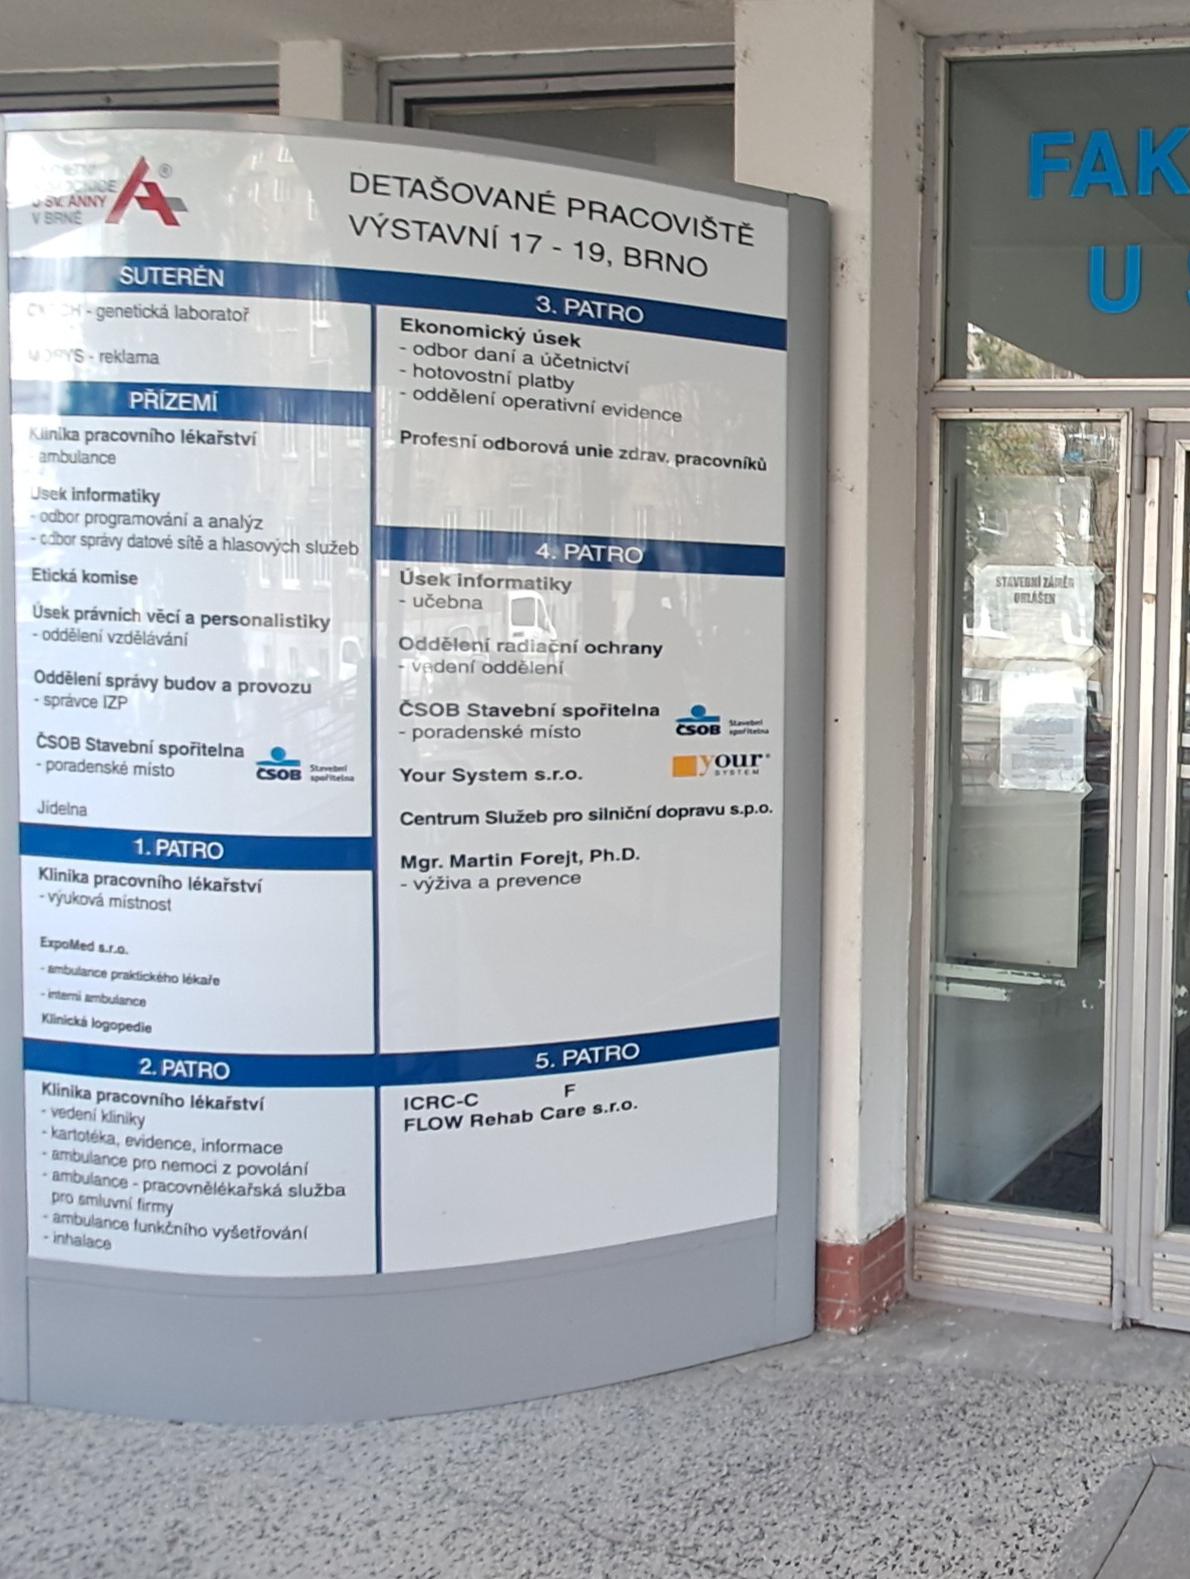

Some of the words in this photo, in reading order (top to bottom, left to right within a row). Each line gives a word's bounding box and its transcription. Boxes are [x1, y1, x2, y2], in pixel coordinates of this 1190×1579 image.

[350, 171, 556, 215] DETAŠOVANÉ
[568, 198, 755, 247] PRACOVIŠTĚ
[348, 212, 498, 250] VÝSTAVNÍ
[510, 232, 542, 254] 17
[575, 241, 613, 268] 19,
[625, 248, 708, 277] BRNO
[120, 266, 224, 288] SUTERÉN
[1089, 244, 1142, 314] U
[96, 304, 169, 321] genetická
[175, 305, 249, 322] laboratoř
[536, 296, 556, 315] 3.
[565, 298, 644, 324] PATRO
[400, 318, 526, 346] Ekonomický
[533, 328, 580, 348] úsek
[100, 350, 159, 365] reklama
[413, 342, 467, 360] odbor
[476, 346, 516, 363] daní
[523, 353, 533, 365] a
[541, 351, 630, 375] účetnictví
[413, 365, 510, 386] hotovostní
[518, 371, 575, 394] platby
[130, 390, 218, 412] PŘÍZEMÍ
[413, 387, 496, 405] oddělení
[502, 393, 595, 415] operativní
[602, 404, 682, 423] evidence
[400, 430, 476, 450] Profesní
[483, 436, 569, 456] odborová
[576, 443, 613, 458] unie
[619, 447, 669, 464] zdrav.
[675, 450, 767, 472] pracovníků
[536, 543, 556, 561] 4.
[564, 545, 643, 563] PATRO
[32, 568, 77, 583] Etická
[82, 570, 138, 585] komise
[400, 570, 450, 587] Úsek
[458, 573, 571, 594] informatiky
[413, 594, 482, 610] učebna
[33, 605, 69, 620] Úsek
[74, 607, 141, 623] právních
[147, 608, 180, 624] věcí
[186, 614, 195, 624] a
[201, 613, 331, 632] personalistiky
[400, 636, 490, 653] Oddělení
[497, 639, 579, 654] radiační
[585, 641, 662, 658] ochrany
[34, 670, 101, 686] Oddělení
[106, 673, 158, 692] správy
[164, 676, 215, 692] budov
[222, 681, 231, 692] a
[238, 681, 311, 695] provozu
[400, 700, 460, 717] ČSOB
[467, 702, 556, 717] Stavební
[562, 704, 660, 721] spořitelna
[412, 723, 523, 742] poradenské
[530, 724, 581, 740] místo
[676, 723, 720, 736] ČSOB
[256, 765, 302, 781] ČSOB
[400, 767, 445, 783] Your
[452, 767, 527, 785] System
[534, 767, 582, 782] s.r.o.
[699, 752, 762, 776] your
[37, 801, 87, 816] Jídelna
[400, 811, 479, 827] Centrum
[485, 808, 548, 824] Služeb
[553, 810, 582, 826] pro
[588, 805, 651, 821] silniční
[656, 804, 725, 820] dopravu
[730, 803, 773, 818] s.p.o.
[133, 838, 150, 856] 1.
[156, 840, 224, 860] PATRO
[401, 854, 443, 873] Mgr.
[450, 853, 513, 869] Martin
[520, 851, 583, 868] Forejt,
[590, 848, 640, 864] Ph.D.
[38, 867, 89, 884] Klinika
[94, 874, 182, 891] pracovního
[188, 877, 262, 893] lékařství
[414, 874, 471, 894] výživa
[479, 877, 489, 889] a
[497, 873, 581, 891] prevence
[41, 936, 95, 954] ExpoMed
[99, 942, 128, 954] s.r.o.
[42, 1013, 87, 1028] Klinická
[92, 1017, 152, 1034] logopedie
[536, 1053, 555, 1069] 5.
[563, 1043, 640, 1067] PATRO
[140, 1058, 156, 1075] 2.
[162, 1060, 230, 1080] PATRO
[404, 1093, 478, 1111] ICRC-C
[565, 1084, 576, 1097] F
[404, 1113, 463, 1132] FLOW
[470, 1109, 533, 1129] Rehab
[540, 1105, 585, 1121] Care
[593, 1100, 637, 1115] s.r.o.
[51, 1127, 120, 1146] kartotéka,
[125, 1136, 196, 1153] evidence,
[201, 1138, 283, 1154] informace
